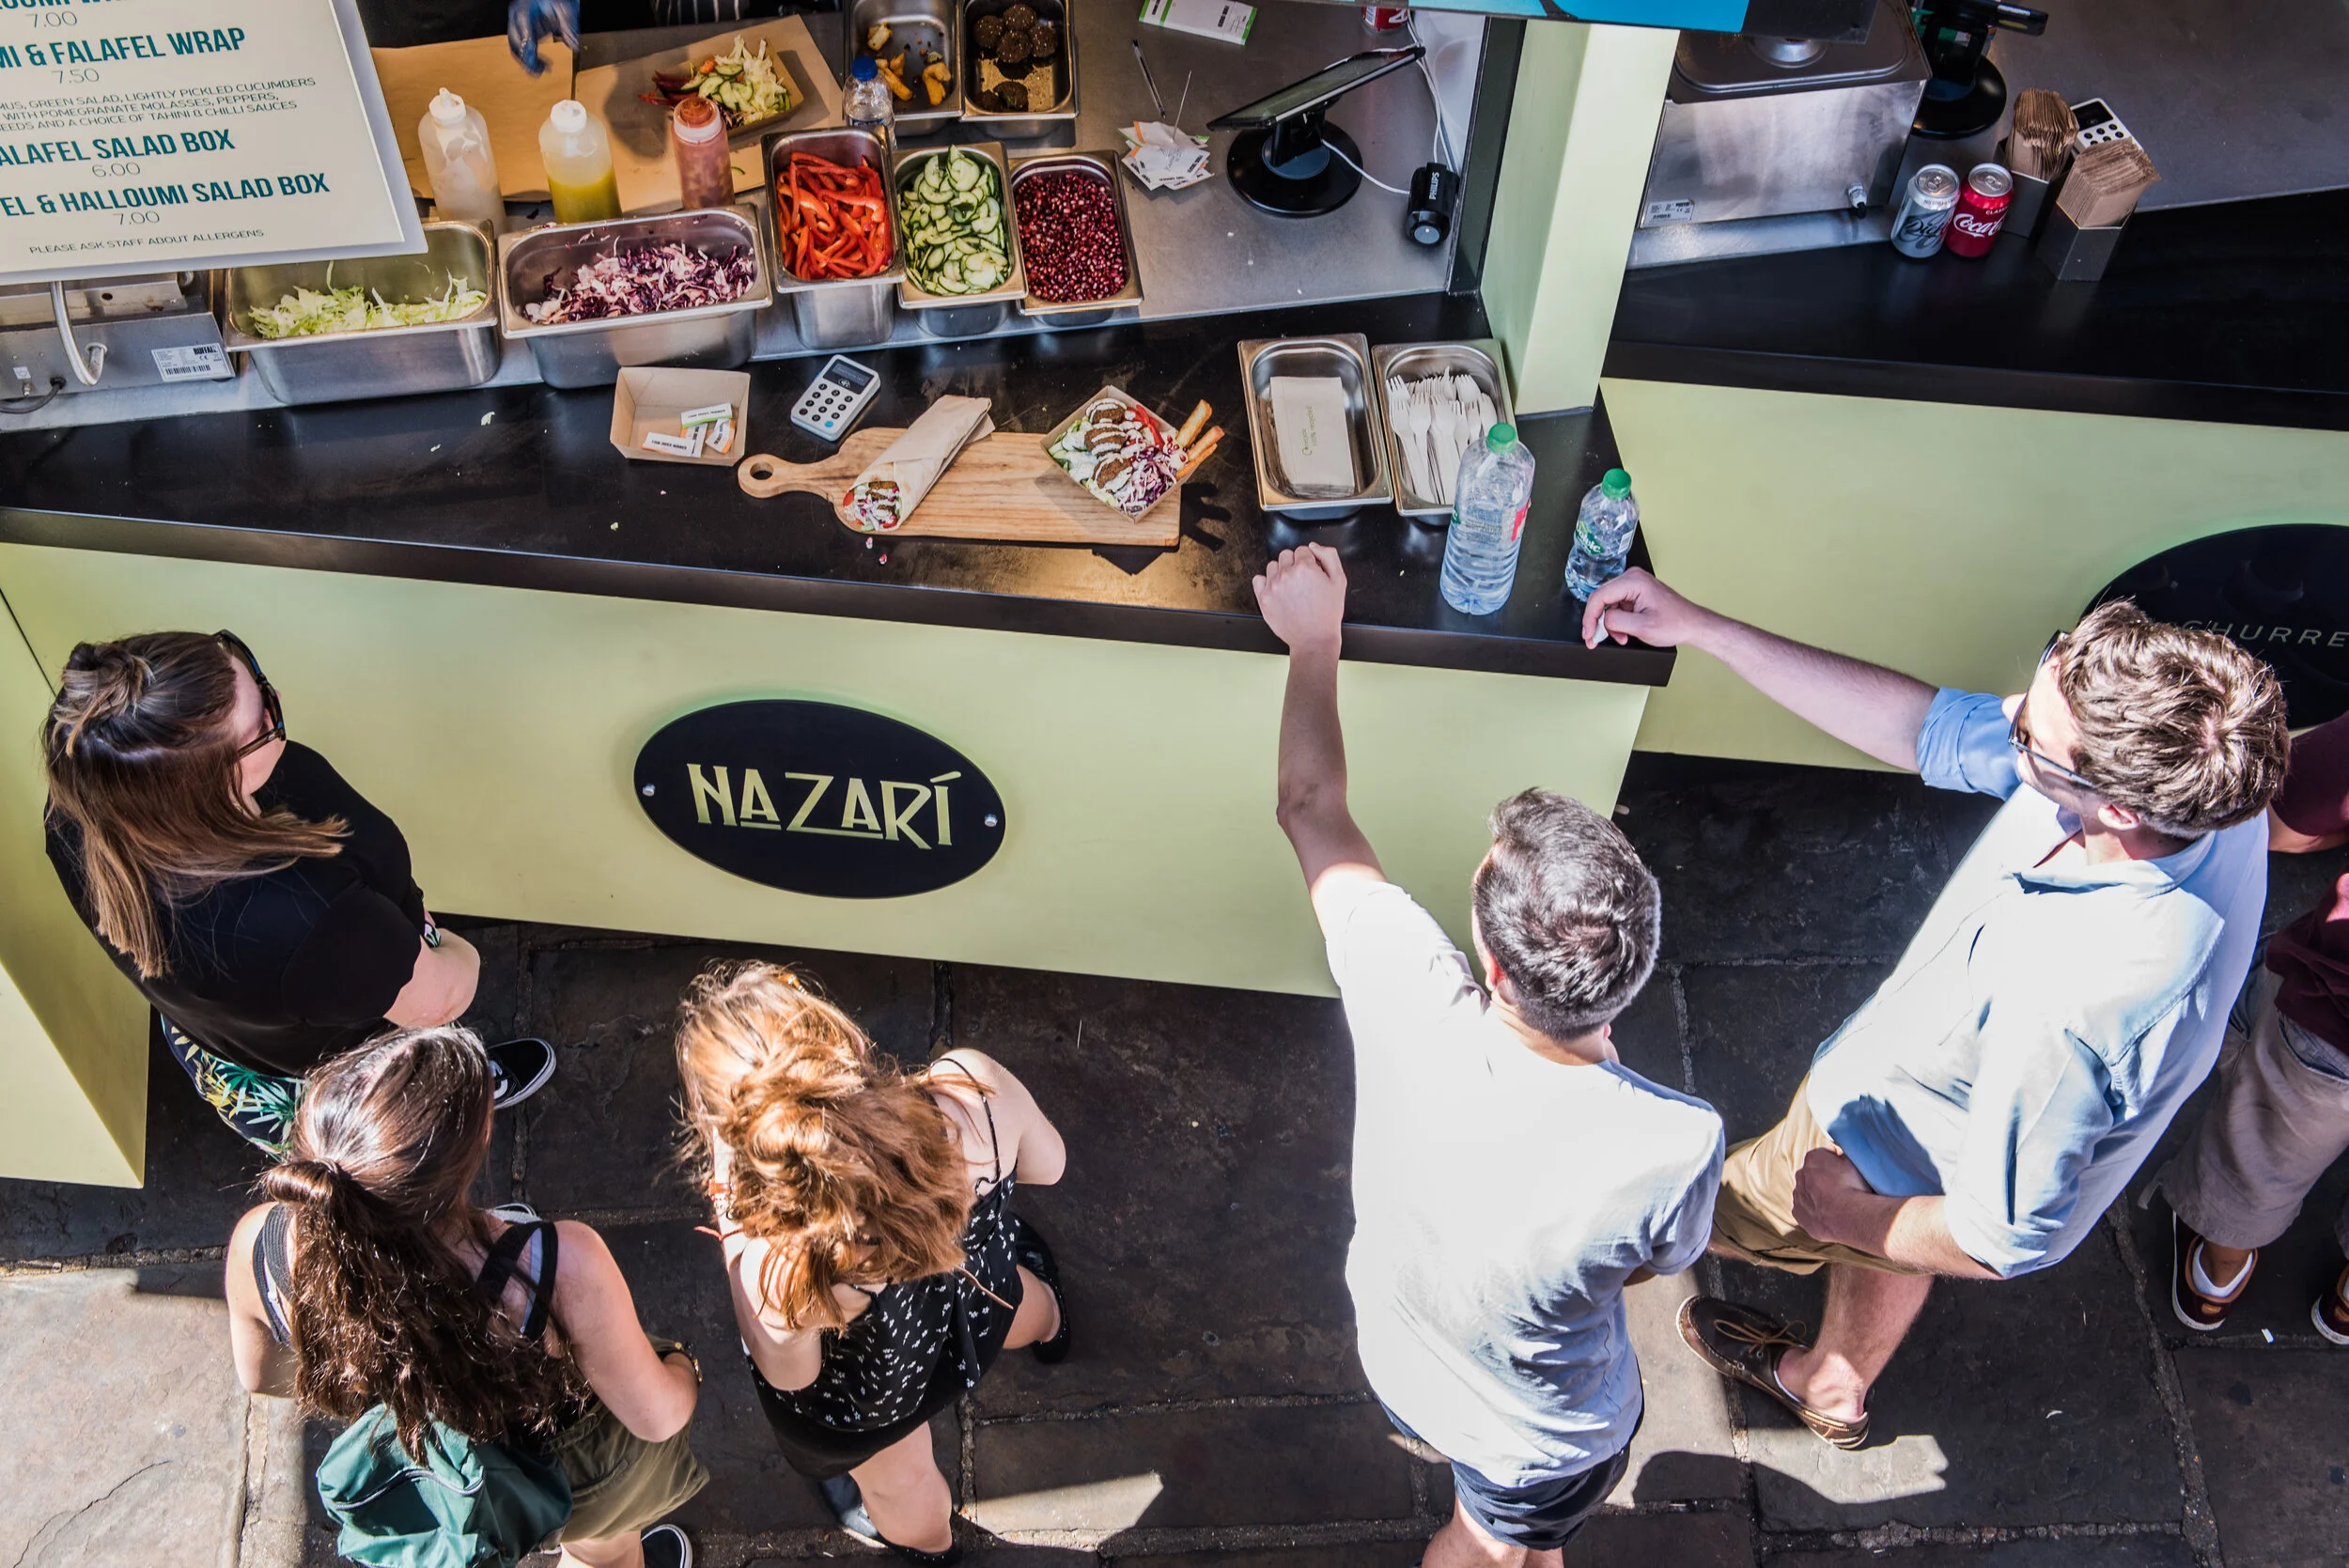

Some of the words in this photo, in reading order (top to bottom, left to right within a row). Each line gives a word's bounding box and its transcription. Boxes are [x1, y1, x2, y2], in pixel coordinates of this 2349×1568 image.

[25, 10, 78, 28] 7.00
[24, 44, 47, 67] &
[49, 35, 166, 65] FALAFEL
[166, 27, 245, 55] WRAP
[51, 68, 100, 85] 7.50
[3, 109, 39, 121] WITH
[40, 103, 140, 118] POMEGRANATE
[141, 98, 214, 111] MOLASSES,
[216, 92, 280, 105] PEPPERS,
[29, 98, 74, 108] GREEN
[76, 94, 123, 105] SALAD,
[125, 89, 177, 101] LIGHTLY
[179, 85, 234, 97] PICKLED
[236, 77, 317, 92] CUCUMBERS
[0, 121, 35, 132] EEDS
[38, 118, 65, 129] AND
[69, 117, 77, 127] A
[79, 115, 128, 126] CHOICE
[129, 113, 147, 123] OF
[150, 110, 191, 121] TAHINI
[194, 109, 204, 117] &
[205, 105, 245, 116] CHILLI
[246, 101, 298, 113] SAUCES
[92, 134, 178, 159] SALAD
[180, 129, 237, 153] BOX
[92, 162, 141, 178] 6.00
[36, 194, 57, 214] &
[59, 183, 189, 212] HALLOUMI
[192, 178, 274, 202] SALAD
[277, 173, 331, 196] BOX
[1429, 171, 1440, 200] PHILIPS
[113, 210, 161, 225] 7.00
[29, 242, 78, 255] PLEASE
[80, 241, 104, 251] ASK
[106, 239, 145, 248] STAFF
[148, 235, 189, 246] ABOUT
[193, 229, 265, 242] ALLERGENS
[686, 763, 962, 849] NAZARÍ
